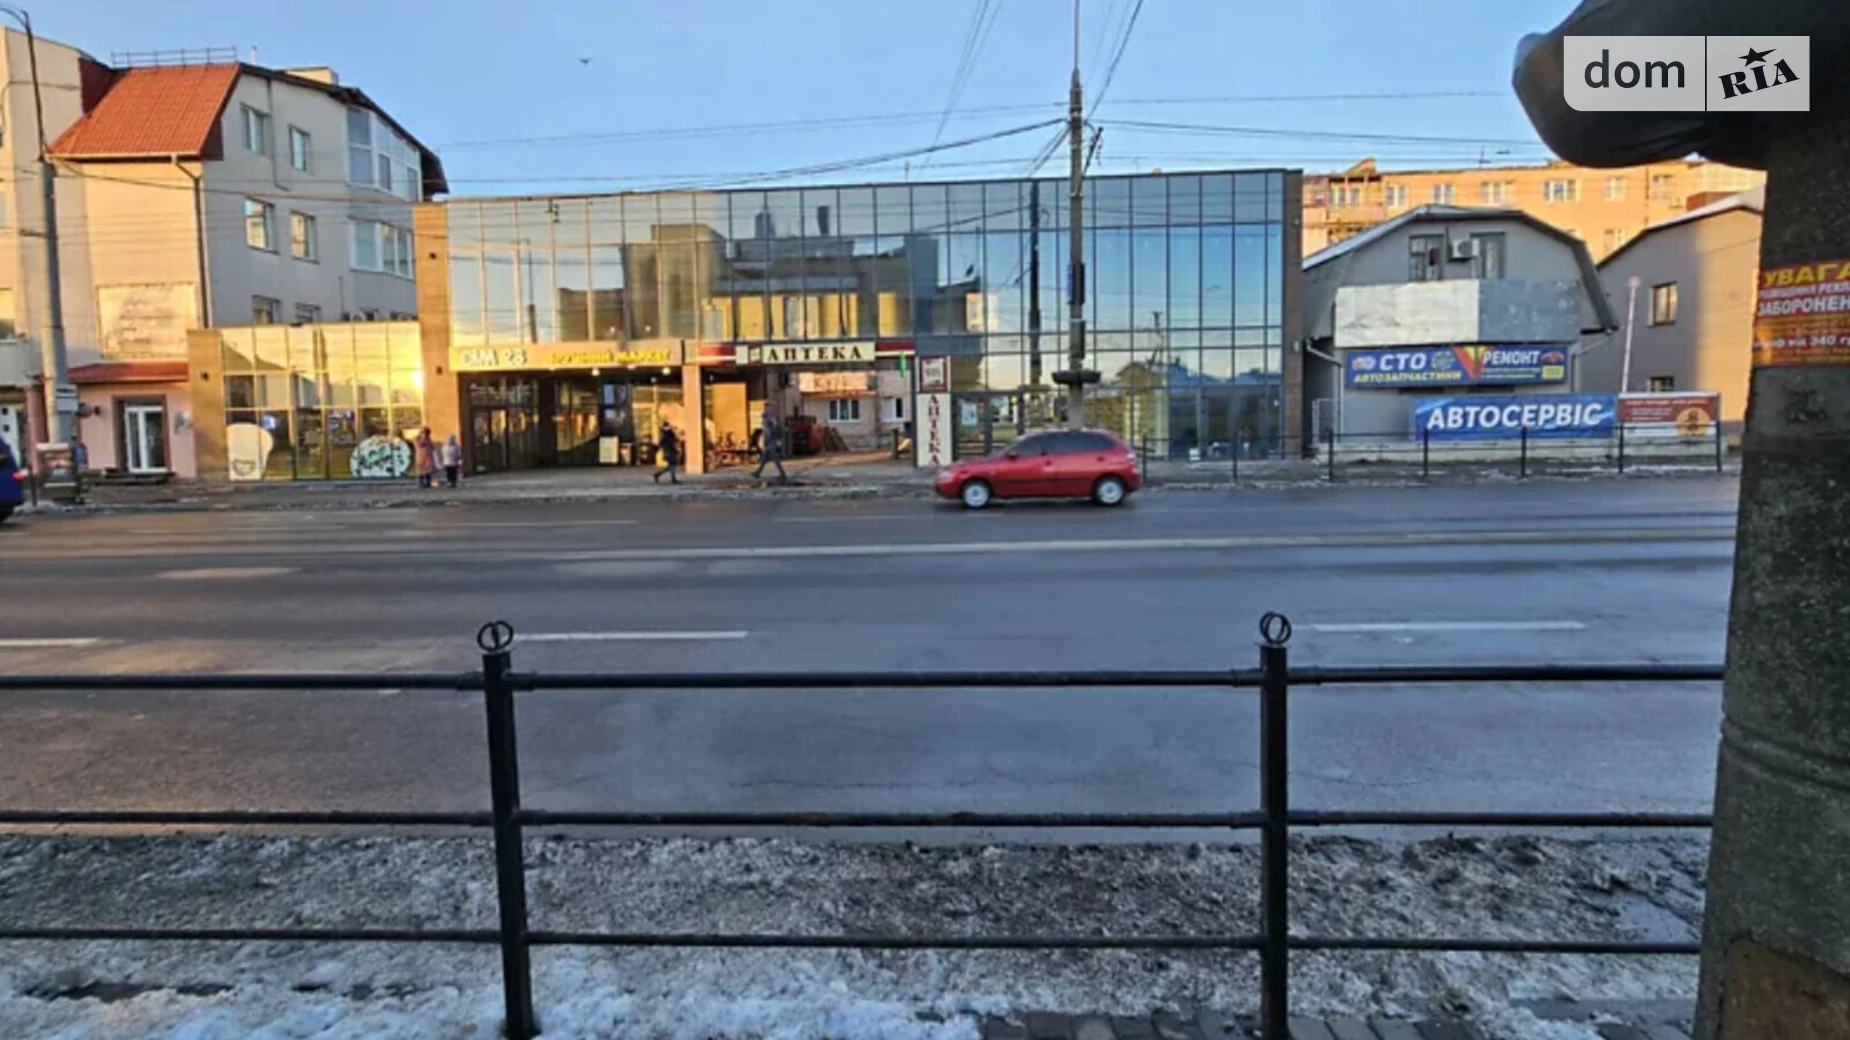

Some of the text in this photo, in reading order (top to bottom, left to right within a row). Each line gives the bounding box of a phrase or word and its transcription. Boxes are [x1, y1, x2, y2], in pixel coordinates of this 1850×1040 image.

[767, 345, 863, 361] АПТЕКА
[1379, 352, 1427, 371] СТО
[1483, 350, 1541, 366] РЕМОНТ
[1354, 370, 1463, 384] АВТОЗАПЧАСТИНИ
[1426, 402, 1604, 430] АВТОСЕРВІС
[927, 395, 941, 465] АПТЕКА
